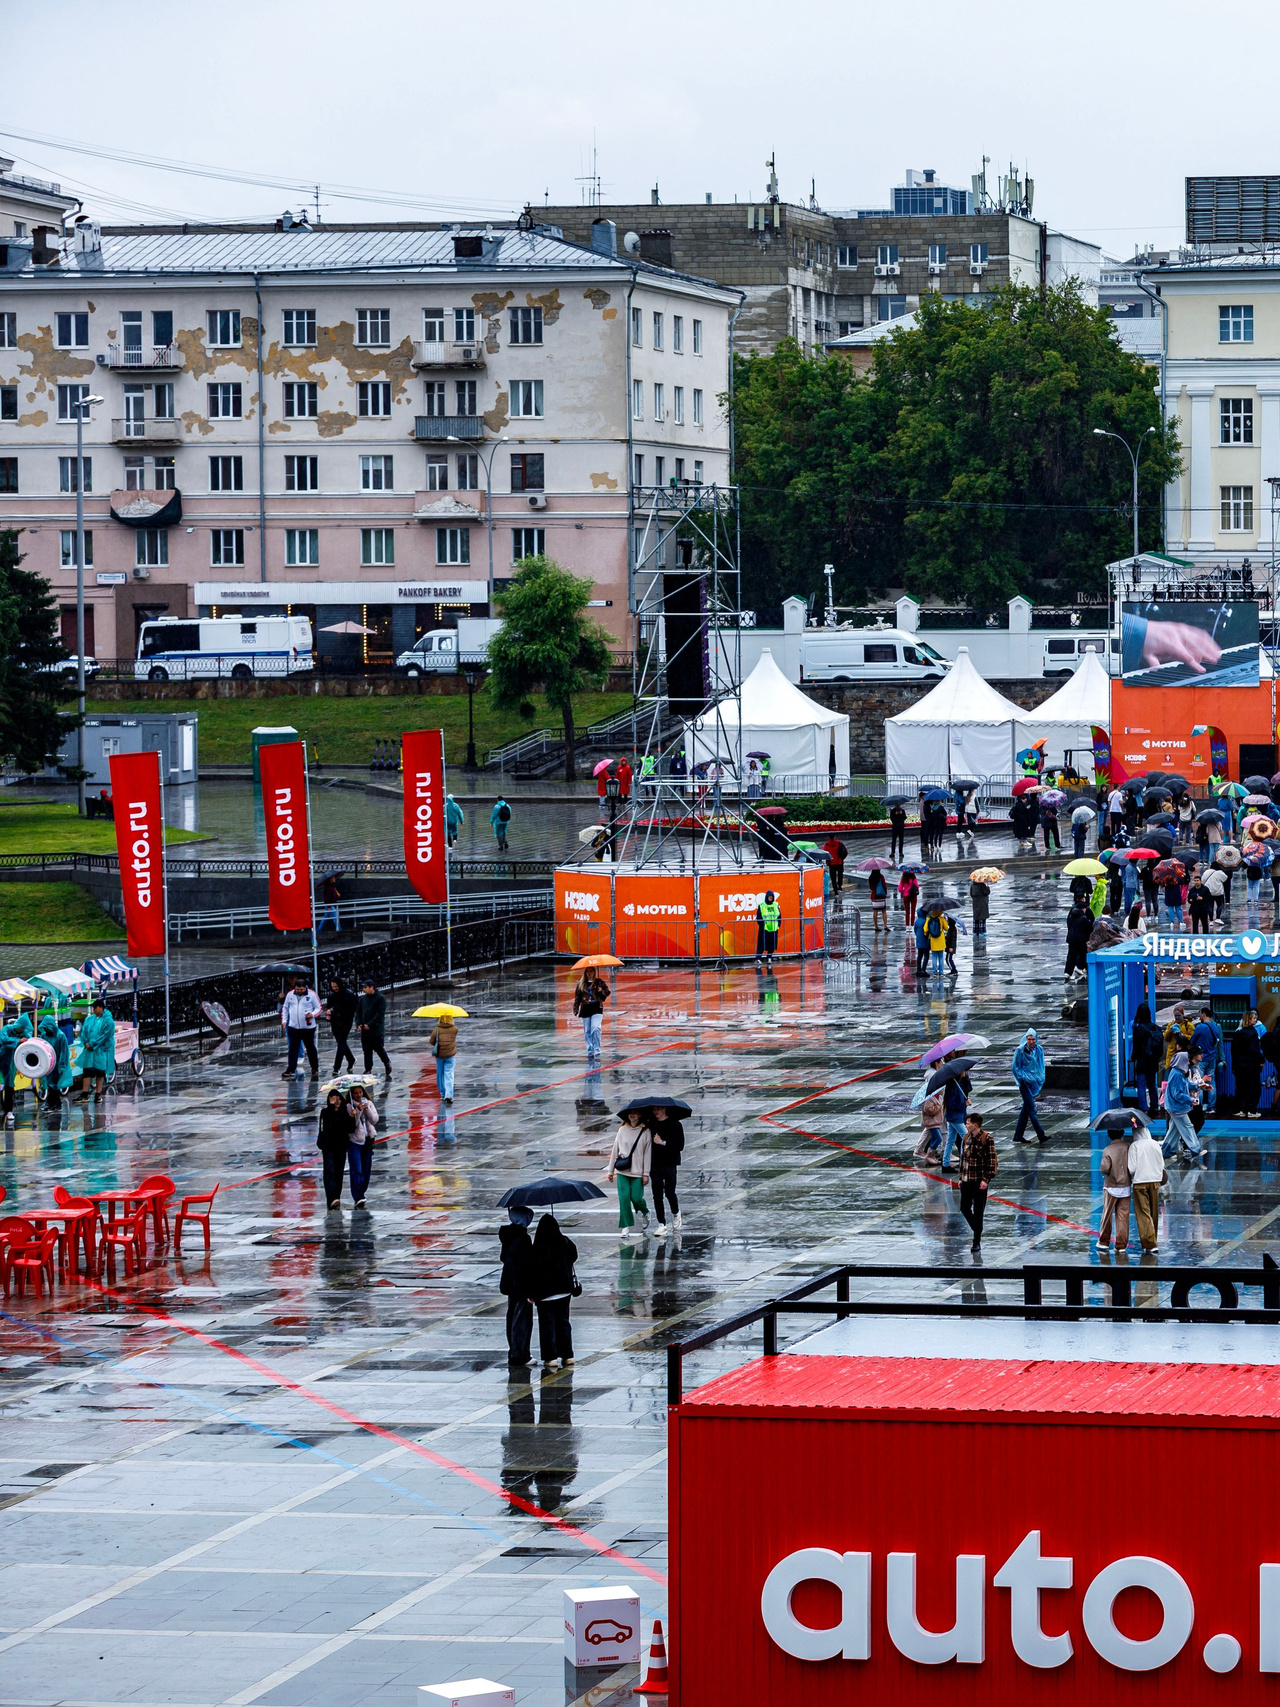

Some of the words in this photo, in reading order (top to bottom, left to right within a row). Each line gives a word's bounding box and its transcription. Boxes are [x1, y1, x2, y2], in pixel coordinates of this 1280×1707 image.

[398, 588, 432, 597] PANKOFF
[434, 587, 462, 597] BAKERY
[414, 772, 433, 863] auto.ru
[275, 788, 297, 887] auto.ru
[129, 801, 151, 907] auto.ru
[564, 891, 600, 912] НОВОЕ
[636, 904, 687, 915] МОТИВ
[1142, 932, 1234, 959] Яндекс
